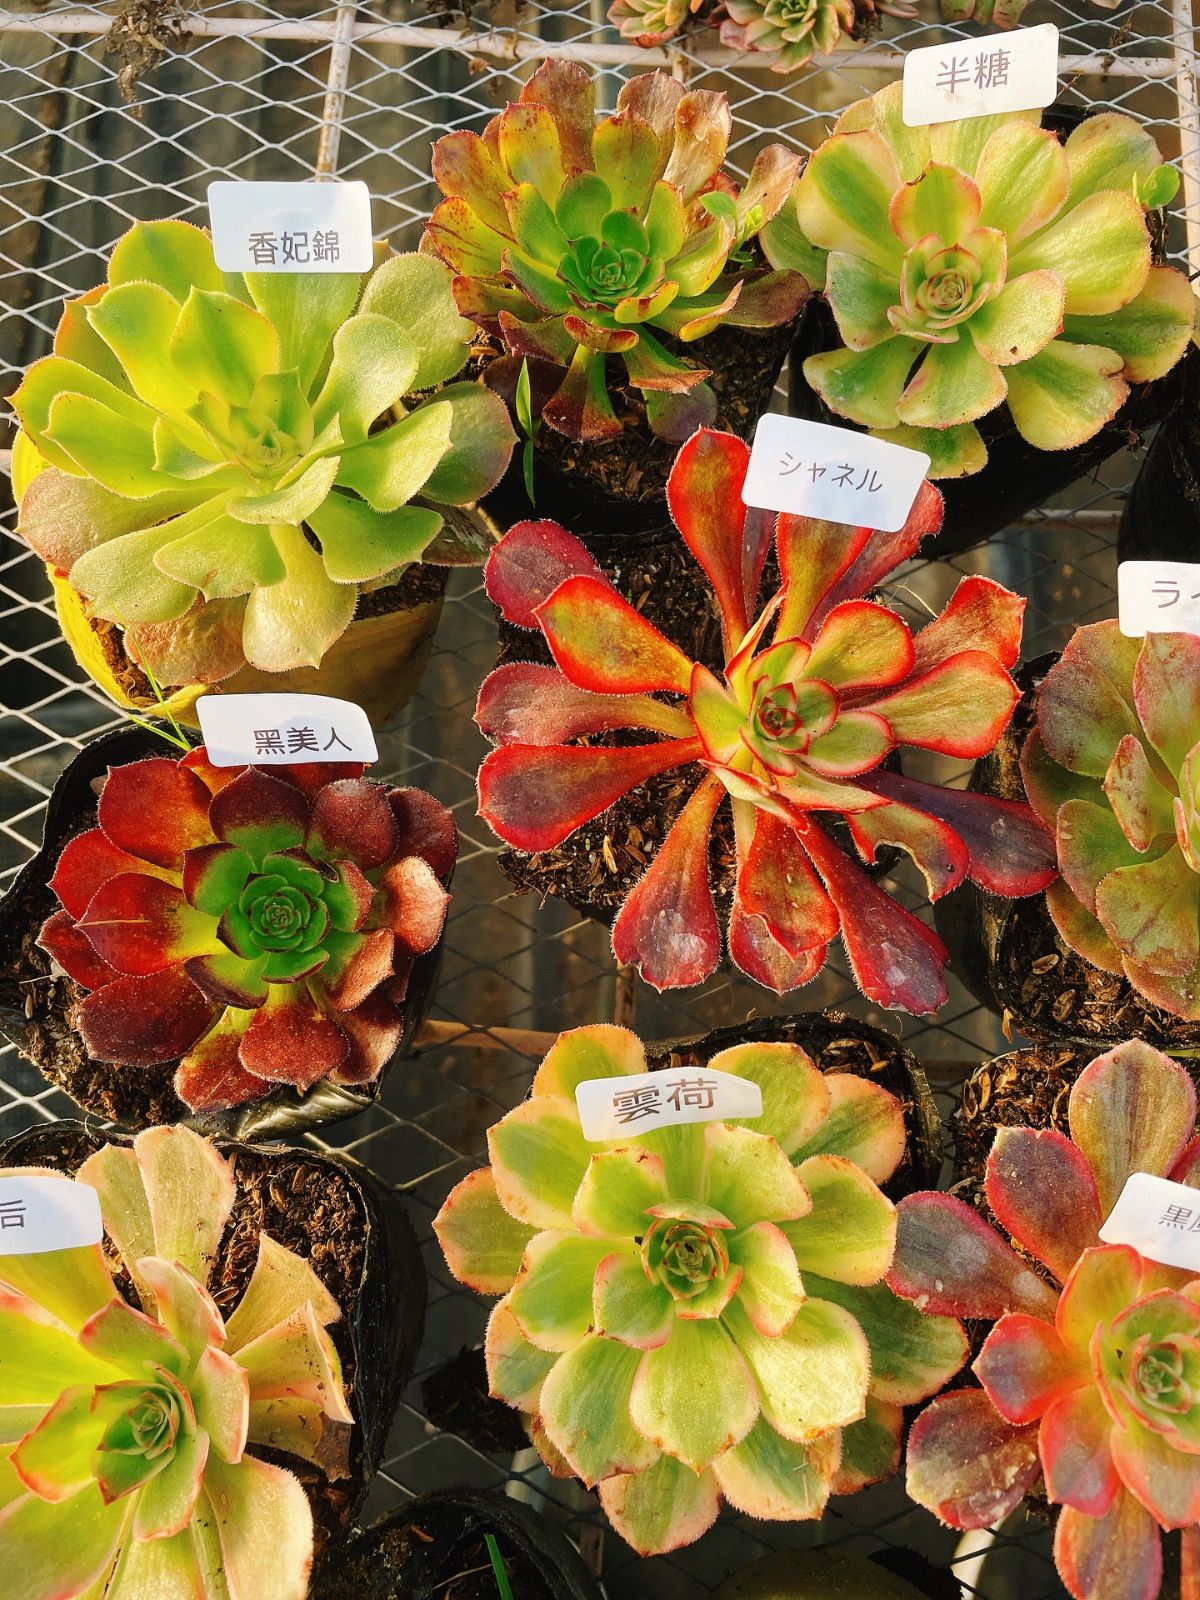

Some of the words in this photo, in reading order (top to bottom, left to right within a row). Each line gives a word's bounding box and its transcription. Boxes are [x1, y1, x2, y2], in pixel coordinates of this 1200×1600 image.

[935, 48, 1011, 94] 半糖
[249, 230, 340, 265] 香妃錦
[779, 452, 883, 493] シャネル
[613, 1077, 718, 1124] 雲荷
